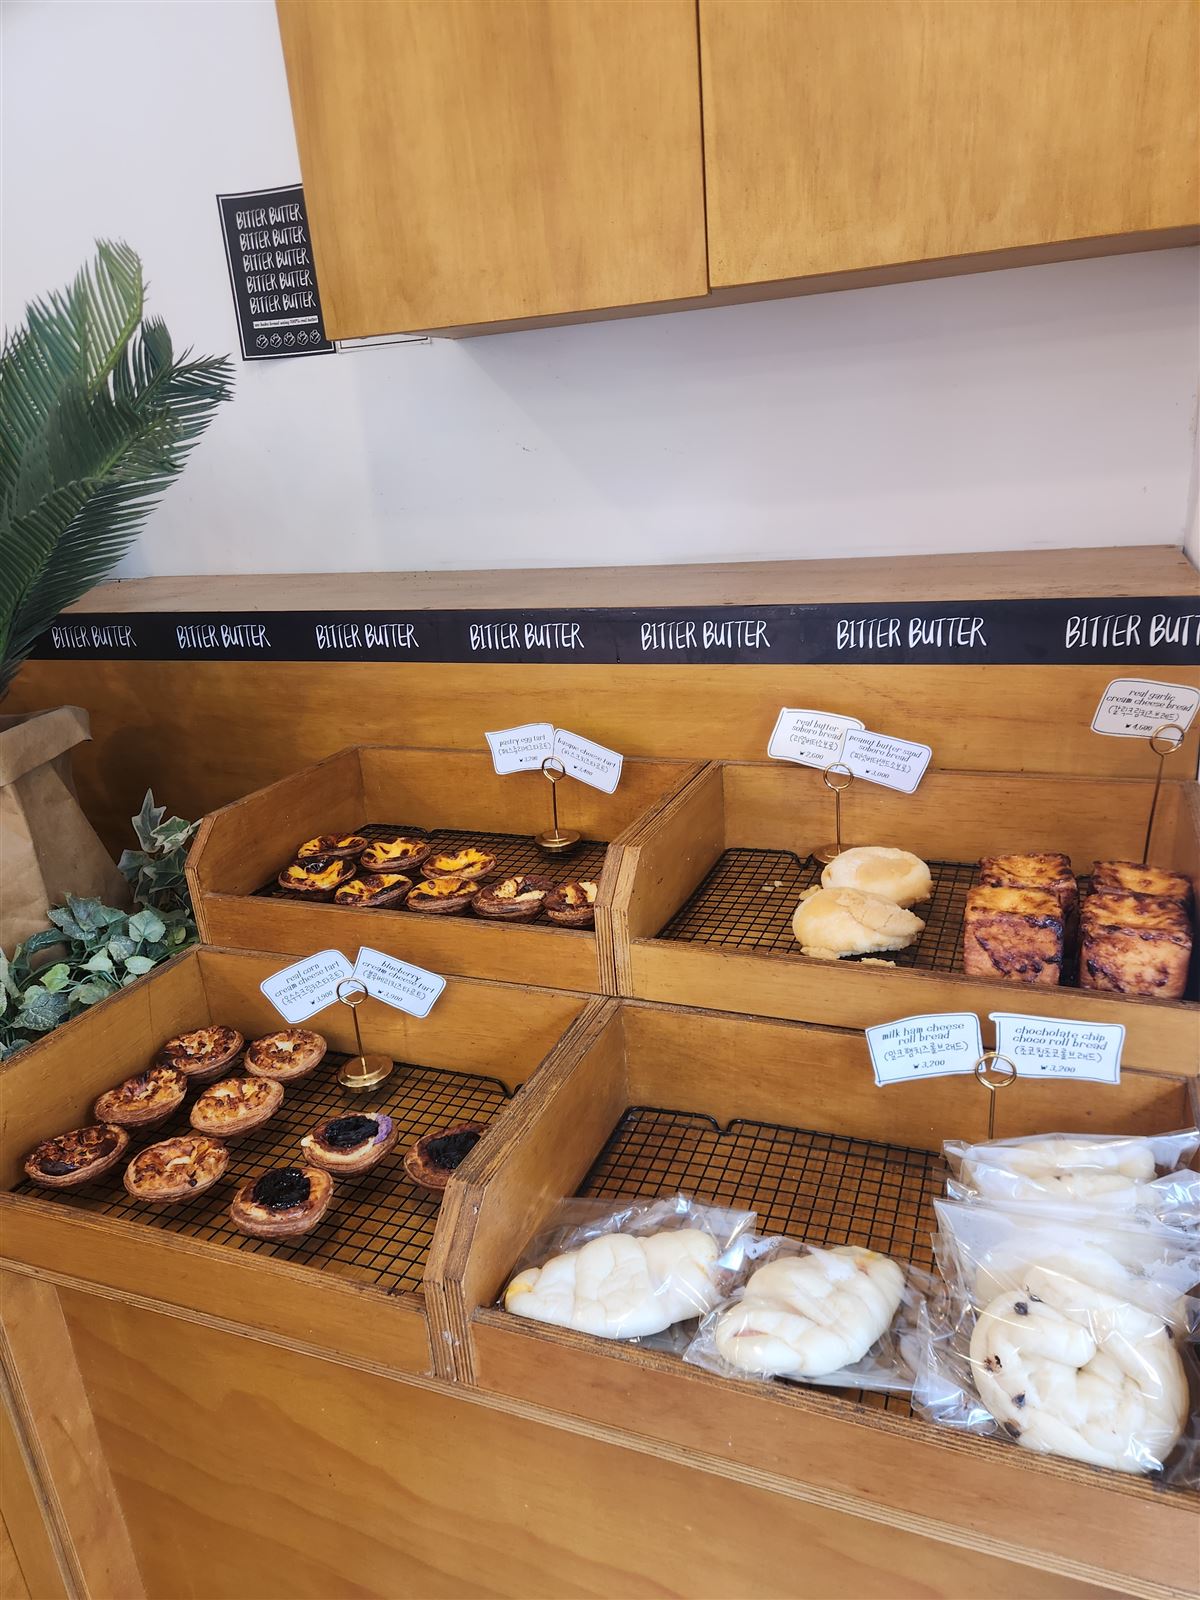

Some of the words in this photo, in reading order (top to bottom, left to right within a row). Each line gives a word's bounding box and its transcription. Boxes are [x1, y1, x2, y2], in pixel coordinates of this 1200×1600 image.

[236, 208, 267, 229] BITTER
[269, 203, 303, 225] BUTTER
[240, 230, 271, 251] BITTER
[272, 226, 306, 247] BUTTER
[243, 252, 274, 272] BITTER
[276, 248, 309, 268] BUTTER
[246, 273, 278, 293] BITTER
[279, 269, 313, 289] BUTTER
[250, 295, 281, 314] BITTER
[283, 291, 316, 310] BUTTER
[51, 626, 90, 648] BITTER
[91, 625, 137, 648] BUTTER
[176, 625, 220, 648] BITTER
[222, 624, 271, 648] BUTTER
[316, 624, 362, 649] BITTER
[365, 623, 419, 648] BUTTER
[470, 623, 520, 651] BITTER
[525, 622, 584, 649] BUTTER
[641, 622, 697, 651] BITTER
[703, 620, 770, 649] BUTTER
[837, 618, 901, 649] BITTER
[908, 617, 987, 648] BUTTER
[1065, 615, 1141, 648] BITTER
[1134, 698, 1165, 708] cheese
[1166, 701, 1194, 711] bread
[1148, 692, 1175, 701] garlic
[792, 724, 817, 735] soboro
[819, 730, 843, 740] bread
[796, 719, 813, 728] real
[814, 720, 839, 731] butter
[849, 736, 875, 746] peanut
[876, 740, 902, 752] butter
[859, 745, 885, 755] soboro
[886, 751, 911, 761] bread
[275, 983, 297, 997] cream
[299, 970, 324, 985] cheese
[325, 961, 339, 972] tart
[286, 971, 302, 983] real
[303, 964, 319, 975] corn
[362, 962, 387, 974] cream
[389, 972, 417, 985] cheese
[418, 983, 435, 993] tart
[382, 961, 421, 982] blueberry
[883, 1029, 900, 1040] milk
[904, 1027, 923, 1036] ham
[926, 1024, 965, 1032] cheese
[899, 1034, 916, 1045] roll
[919, 1031, 950, 1042] bread
[1013, 1035, 1045, 1044] choco
[1049, 1038, 1069, 1046] roll
[1073, 1039, 1108, 1051] bread
[1015, 1026, 1079, 1039] chocholate
[1082, 1032, 1105, 1042] chip
